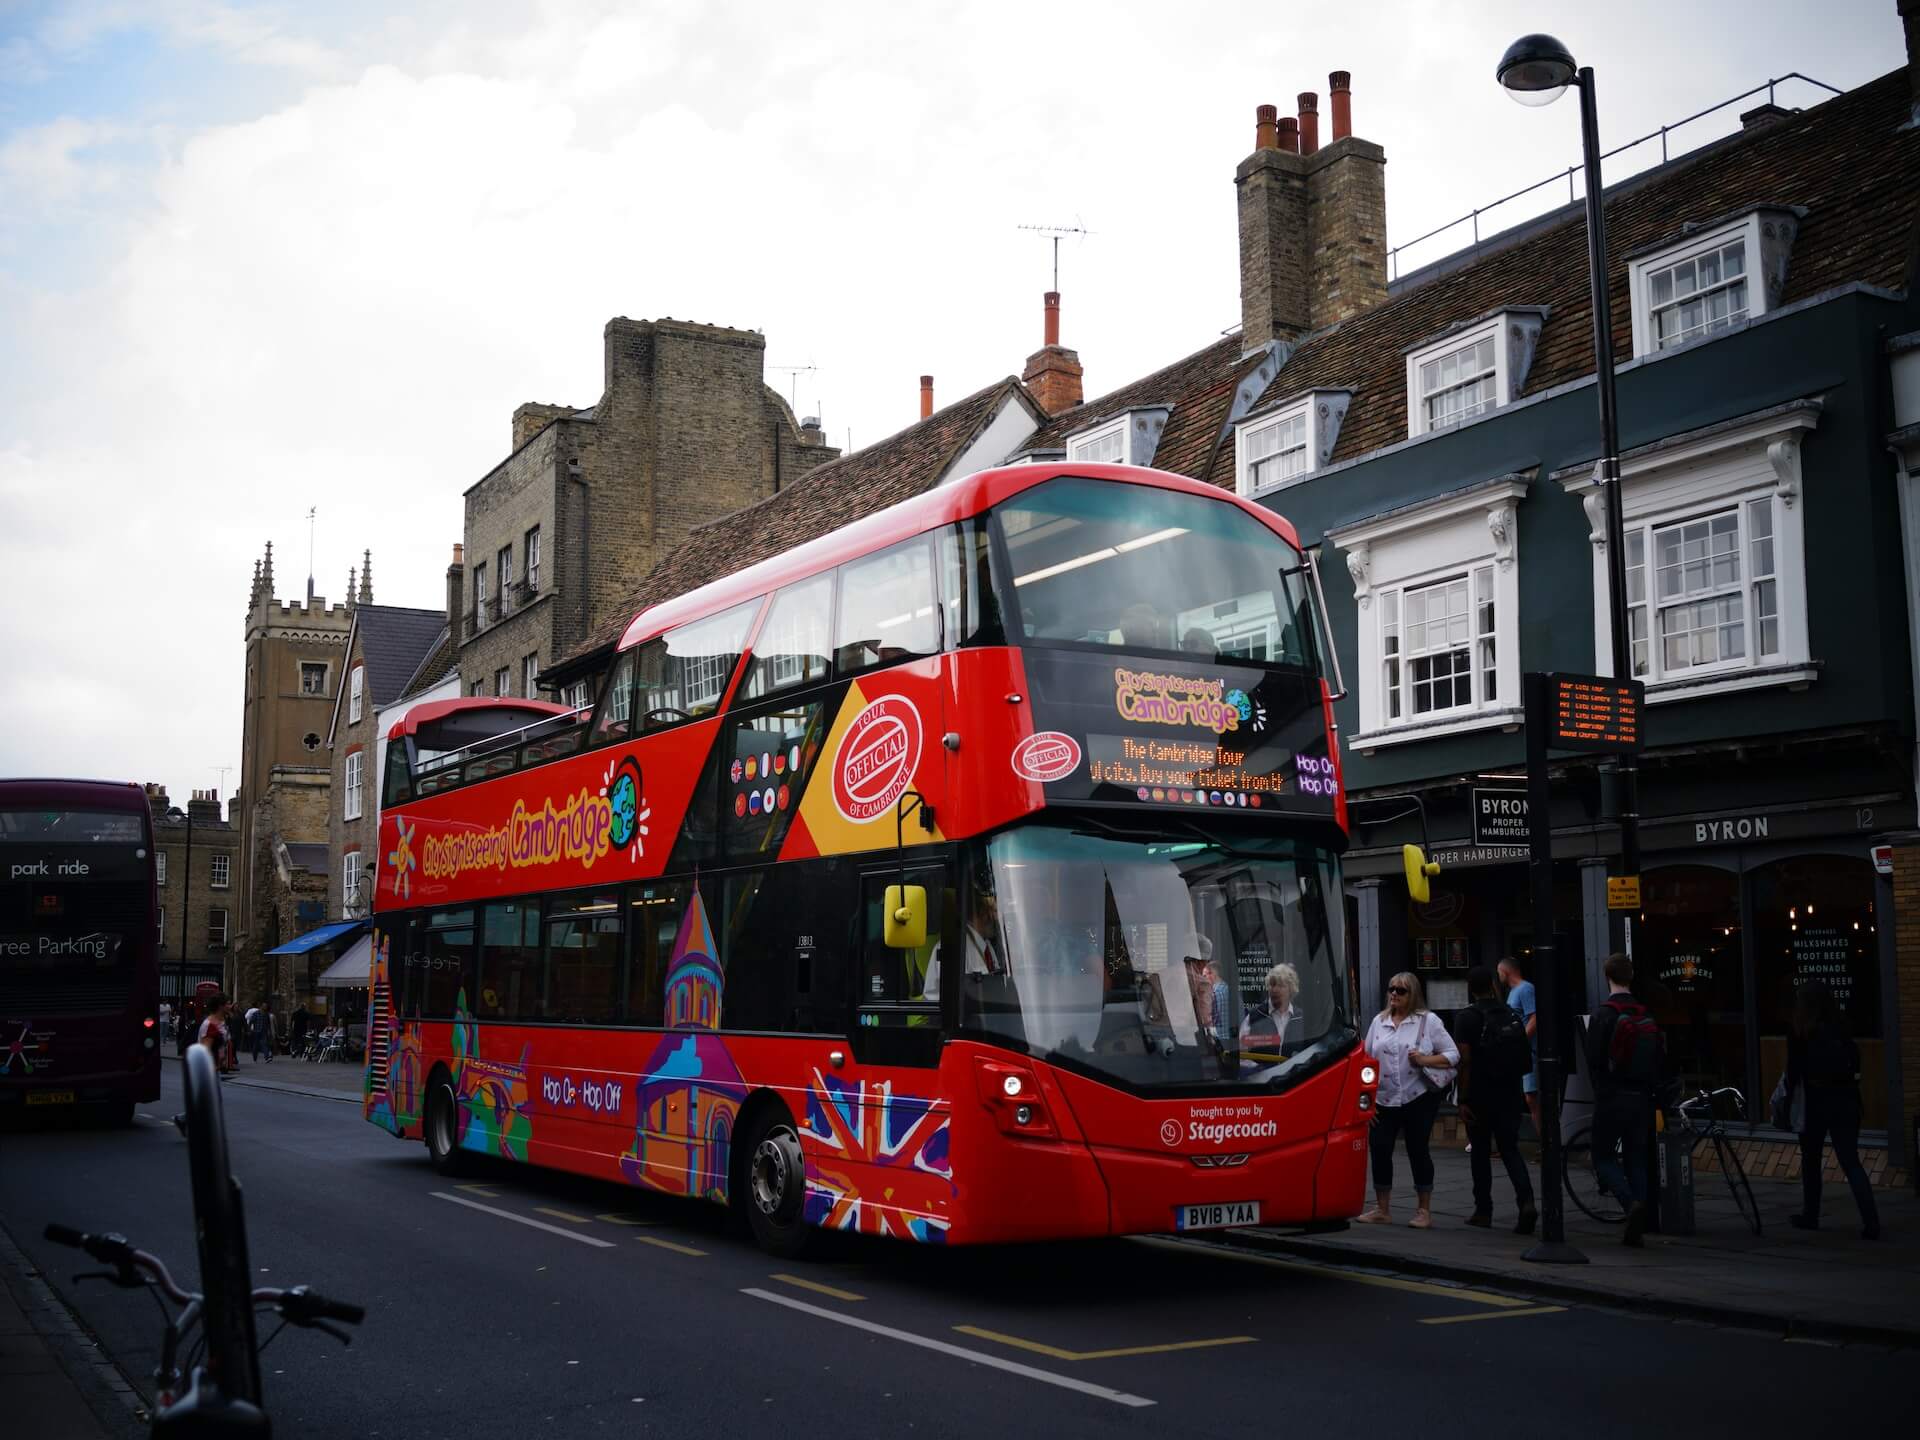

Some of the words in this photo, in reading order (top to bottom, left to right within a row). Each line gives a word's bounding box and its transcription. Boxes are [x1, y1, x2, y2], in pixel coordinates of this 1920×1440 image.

[856, 703, 886, 731] TOUR
[1117, 687, 1239, 733] Cambridge
[847, 732, 905, 785] OFFICIAL
[1025, 747, 1069, 767] OFFICIAL
[1123, 738, 1147, 758] The
[1150, 741, 1214, 764] Cambridge
[1216, 746, 1244, 766] Tour
[1296, 753, 1319, 772] Hop
[1321, 757, 1335, 773] On
[1140, 763, 1163, 784] Buy
[1167, 769, 1195, 785] your
[1199, 768, 1237, 788] ticket
[1241, 771, 1270, 790] from
[1300, 775, 1322, 794] Hop
[1324, 778, 1338, 794] Off
[850, 802, 861, 817] OF
[862, 764, 911, 817] CAMBRIDGE
[509, 788, 612, 868] Cambridge
[1492, 818, 1524, 827] PROPER
[1856, 808, 1873, 829] 12
[1481, 827, 1530, 836] HAMBURGER
[1696, 817, 1768, 842] BYRON
[1432, 851, 1459, 864] OPER
[1463, 847, 1531, 861] HAMBURGER
[11, 859, 49, 879] park
[58, 859, 89, 875] ride
[0, 942, 31, 955] ree
[39, 937, 106, 959] Parking
[1793, 938, 1849, 948] MILKSHAKES
[1797, 952, 1820, 961] ROOT
[1824, 951, 1846, 961] BEER
[1798, 964, 1847, 973] LEMONADE
[1830, 976, 1853, 985] BEER
[1833, 989, 1850, 999] EER
[543, 1076, 561, 1104] Hop
[563, 1077, 575, 1104] On
[583, 1081, 602, 1111] Hop
[605, 1082, 621, 1110] Off
[1190, 1106, 1223, 1120] brought
[1225, 1106, 1234, 1117] to
[1236, 1107, 1251, 1119] you
[1253, 1105, 1264, 1118] by
[1189, 1120, 1277, 1144] Stagecoach
[1190, 1207, 1222, 1226] BV18
[1226, 1204, 1254, 1223] YAA
